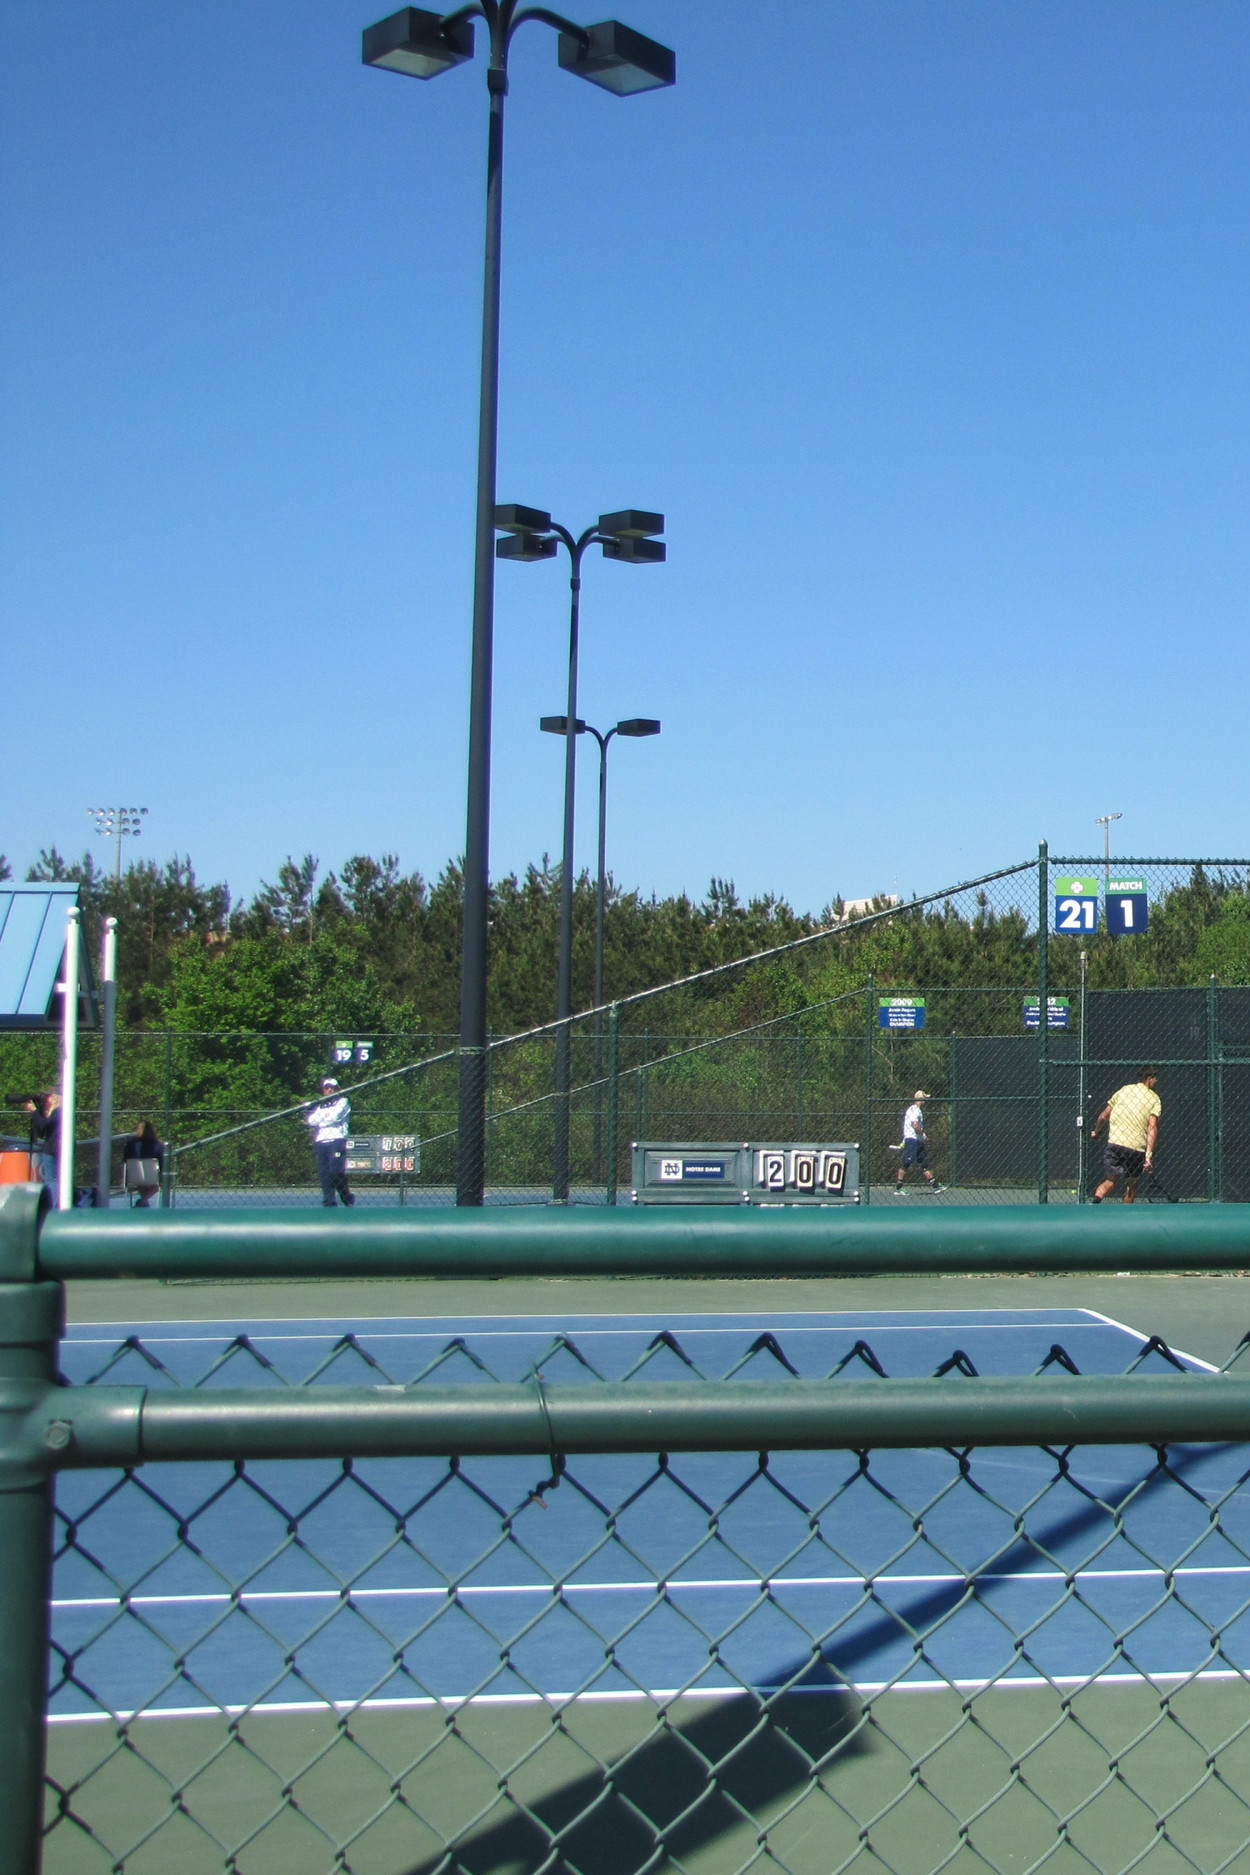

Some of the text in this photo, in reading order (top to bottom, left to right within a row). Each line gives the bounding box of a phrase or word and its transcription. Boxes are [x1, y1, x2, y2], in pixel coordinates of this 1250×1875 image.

[1109, 881, 1143, 891] MATCH
[1059, 899, 1094, 929] 21
[1120, 899, 1134, 928] 1
[336, 1049, 352, 1061] 19
[360, 1049, 370, 1061] 5
